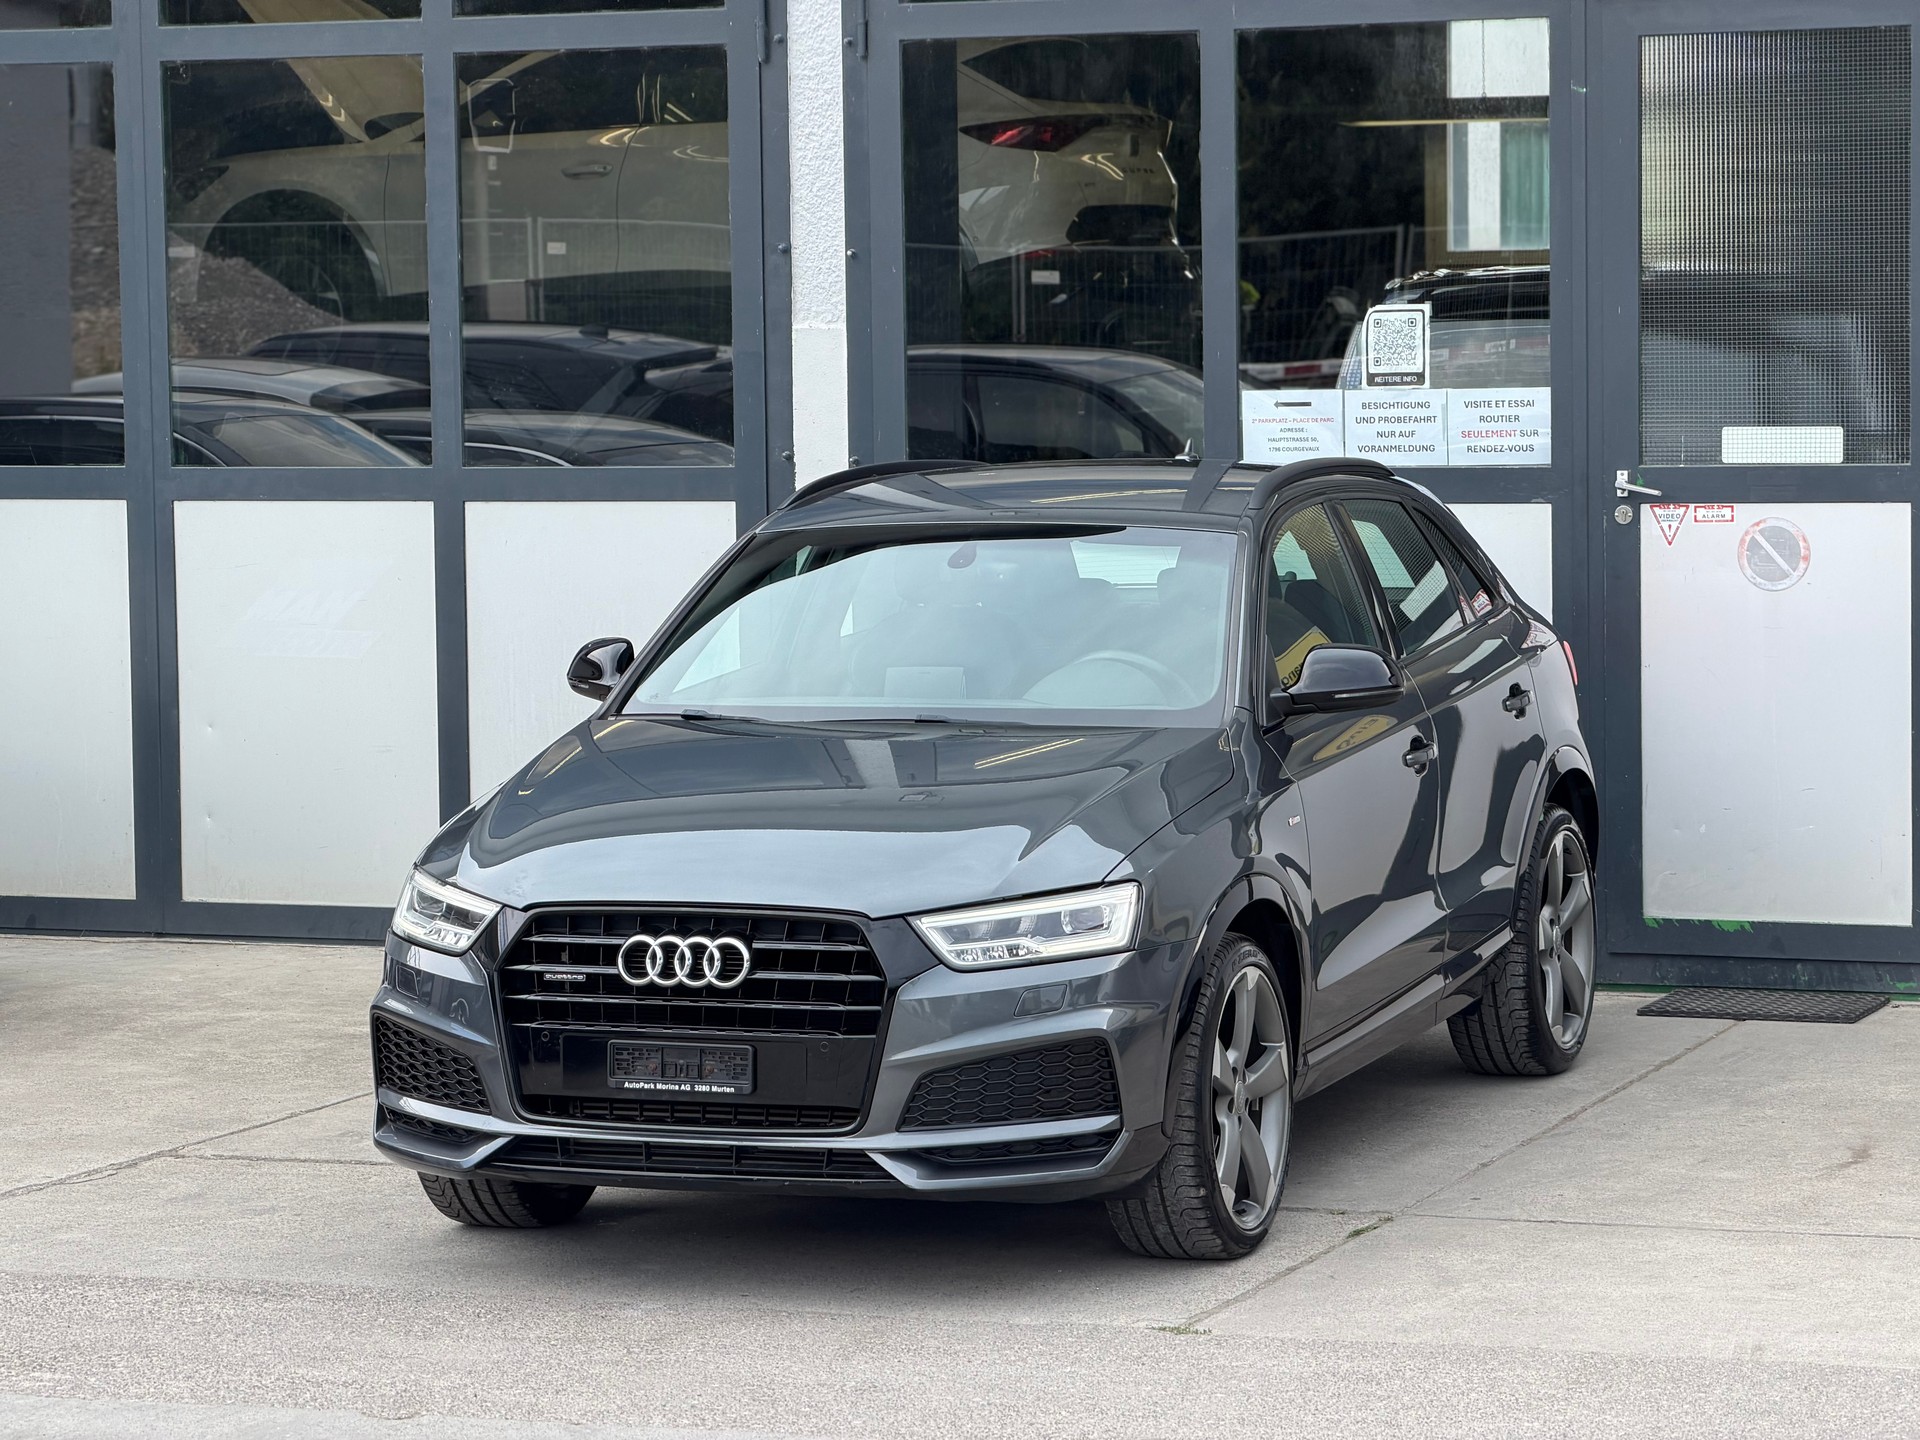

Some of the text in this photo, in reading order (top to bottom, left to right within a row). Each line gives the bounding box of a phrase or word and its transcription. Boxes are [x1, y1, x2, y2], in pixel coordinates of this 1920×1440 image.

[1361, 401, 1430, 410] BESICHTIGUNG
[1463, 399, 1535, 408] VISITE ET ESSAI
[1355, 415, 1437, 424] UND PROBEFAHRT
[1479, 415, 1520, 423] ROUTIER
[1398, 430, 1416, 438] AUF
[1461, 429, 1539, 438] SEULEMENT SUR
[1357, 444, 1436, 453] VORANMELDUNG
[1466, 444, 1535, 453] RENDEZ-VOUS
[624, 1081, 655, 1089] AutoPark
[694, 1084, 710, 1092] 3280
[711, 1085, 735, 1093] Murten
